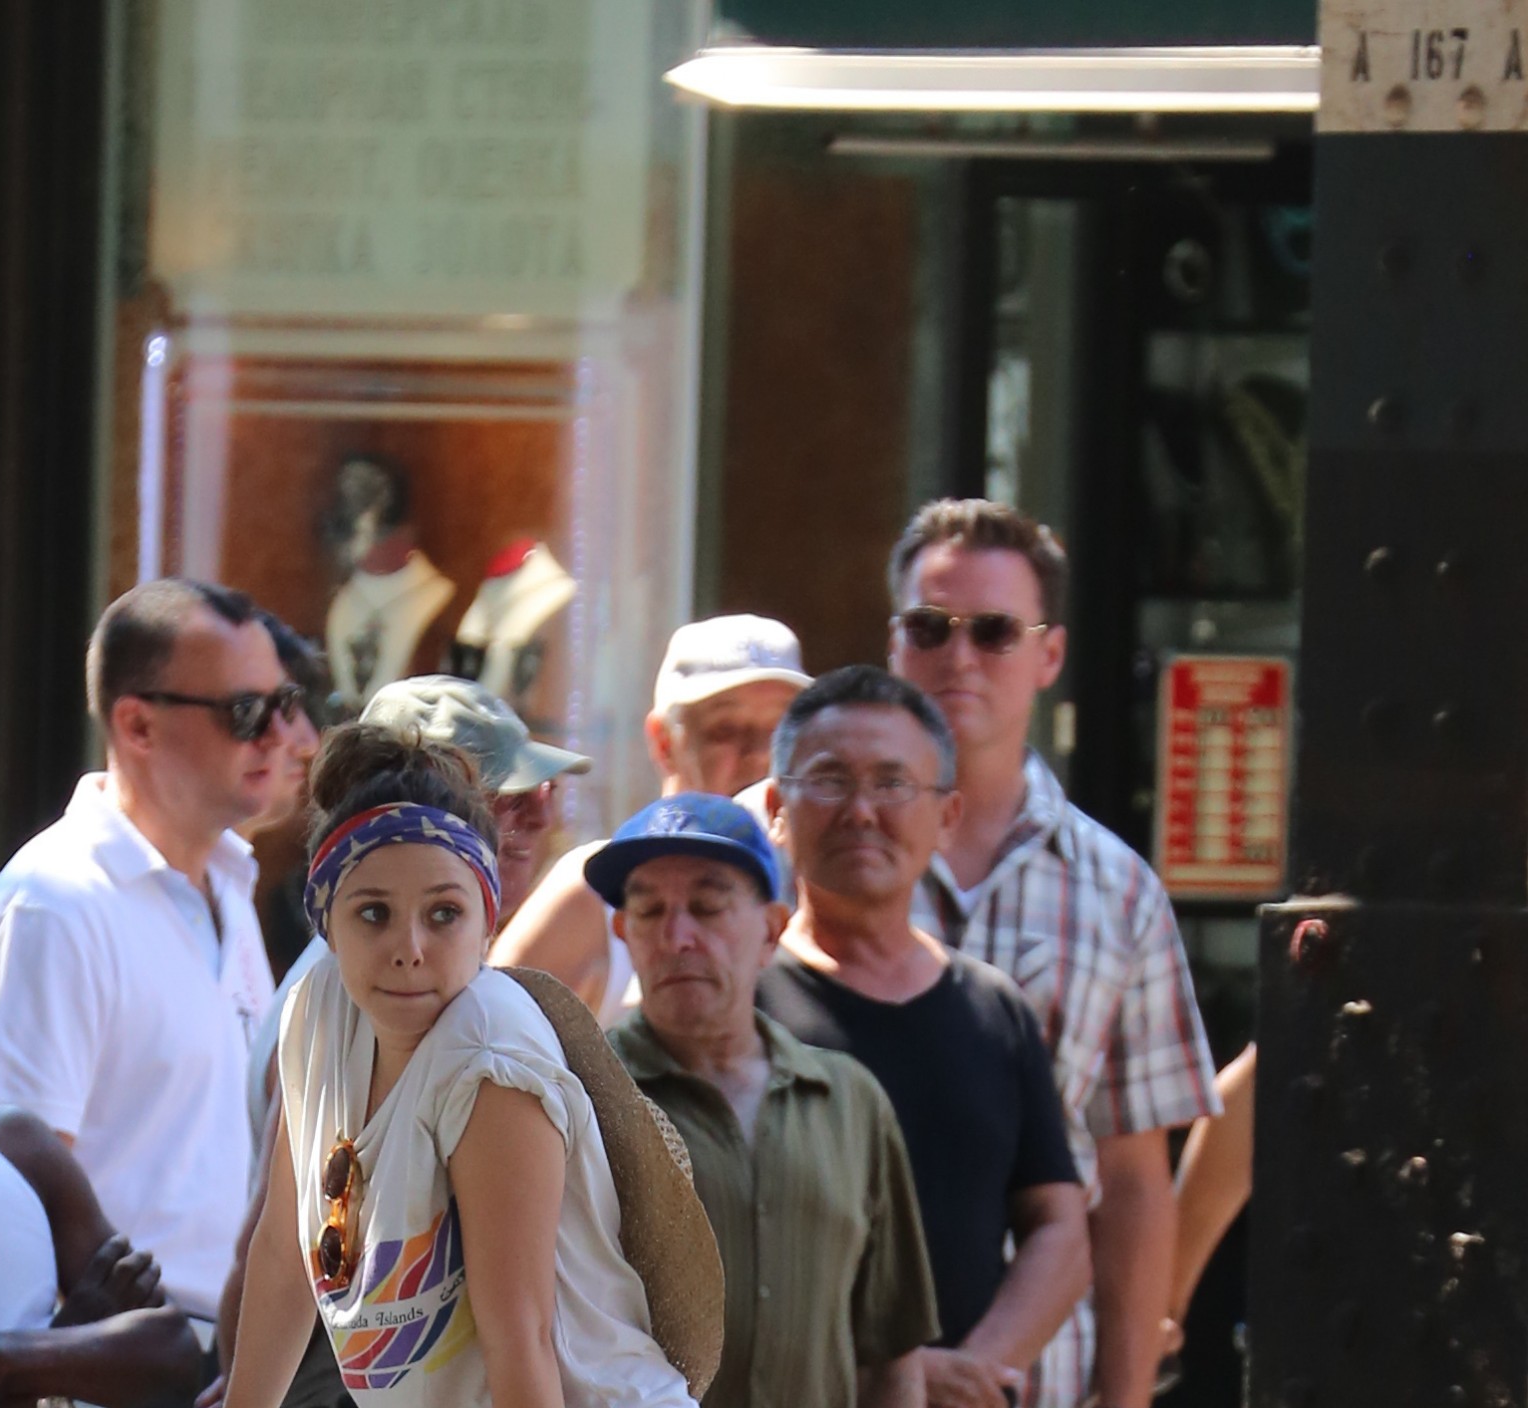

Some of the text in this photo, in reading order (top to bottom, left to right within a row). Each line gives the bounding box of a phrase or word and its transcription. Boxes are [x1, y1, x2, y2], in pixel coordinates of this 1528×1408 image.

[1351, 30, 1370, 82] A
[1411, 27, 1469, 81] 167
[375, 1306, 424, 1327] Islands
